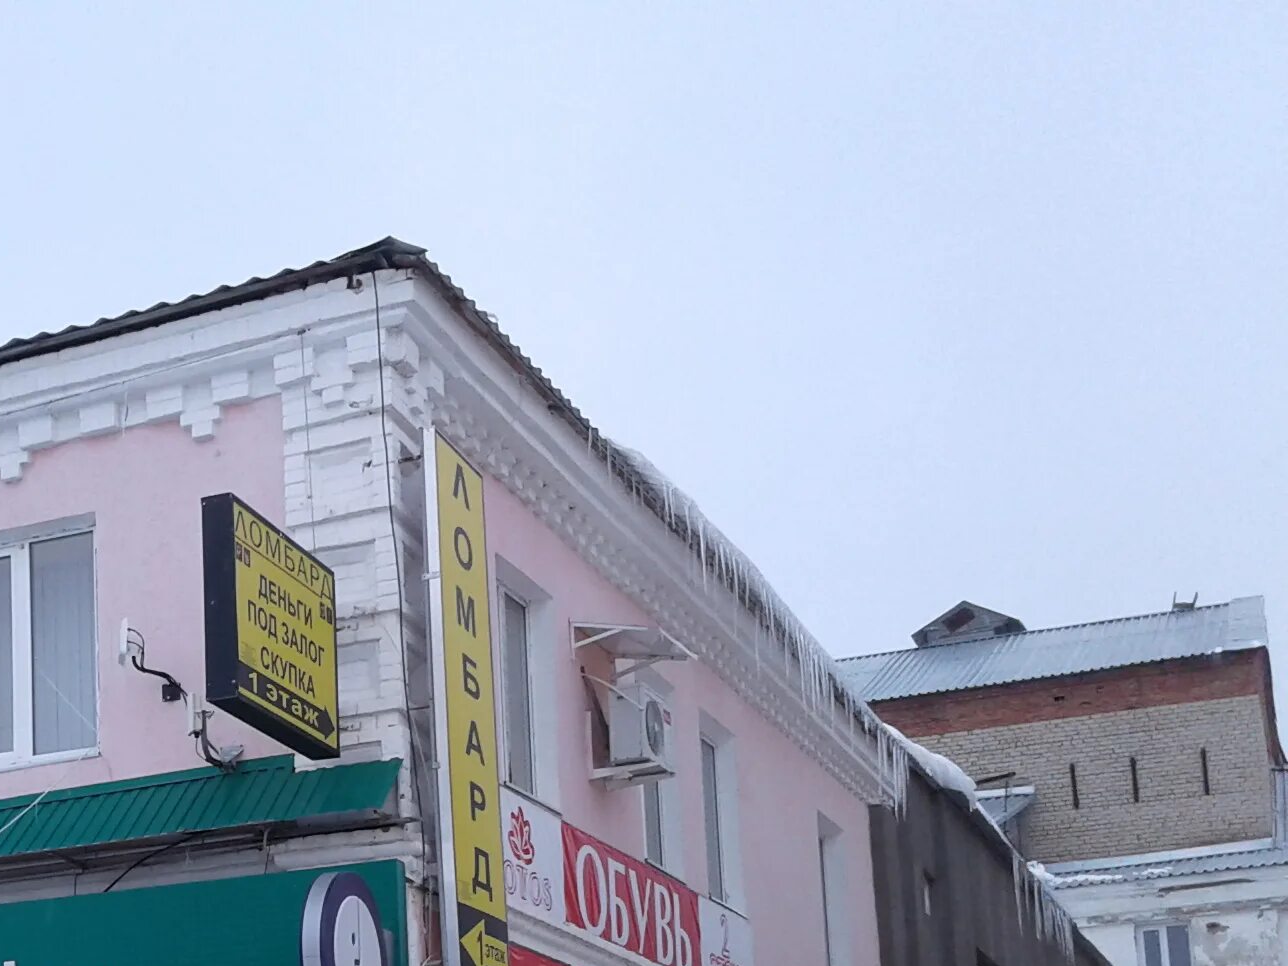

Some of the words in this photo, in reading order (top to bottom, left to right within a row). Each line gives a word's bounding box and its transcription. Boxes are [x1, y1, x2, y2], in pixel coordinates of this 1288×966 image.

[235, 510, 332, 601] ЛОМБАРД
[259, 574, 313, 629] ДЕНЬГИ
[248, 600, 278, 643] ПОД
[282, 622, 324, 667] ЗАЛОГ
[261, 646, 315, 698] СКУПКА
[453, 463, 493, 902] ЛОМБАРД
[248, 672, 258, 694] 1
[266, 683, 319, 728] этаж
[503, 859, 553, 912] OTOS
[476, 930, 483, 966] 1
